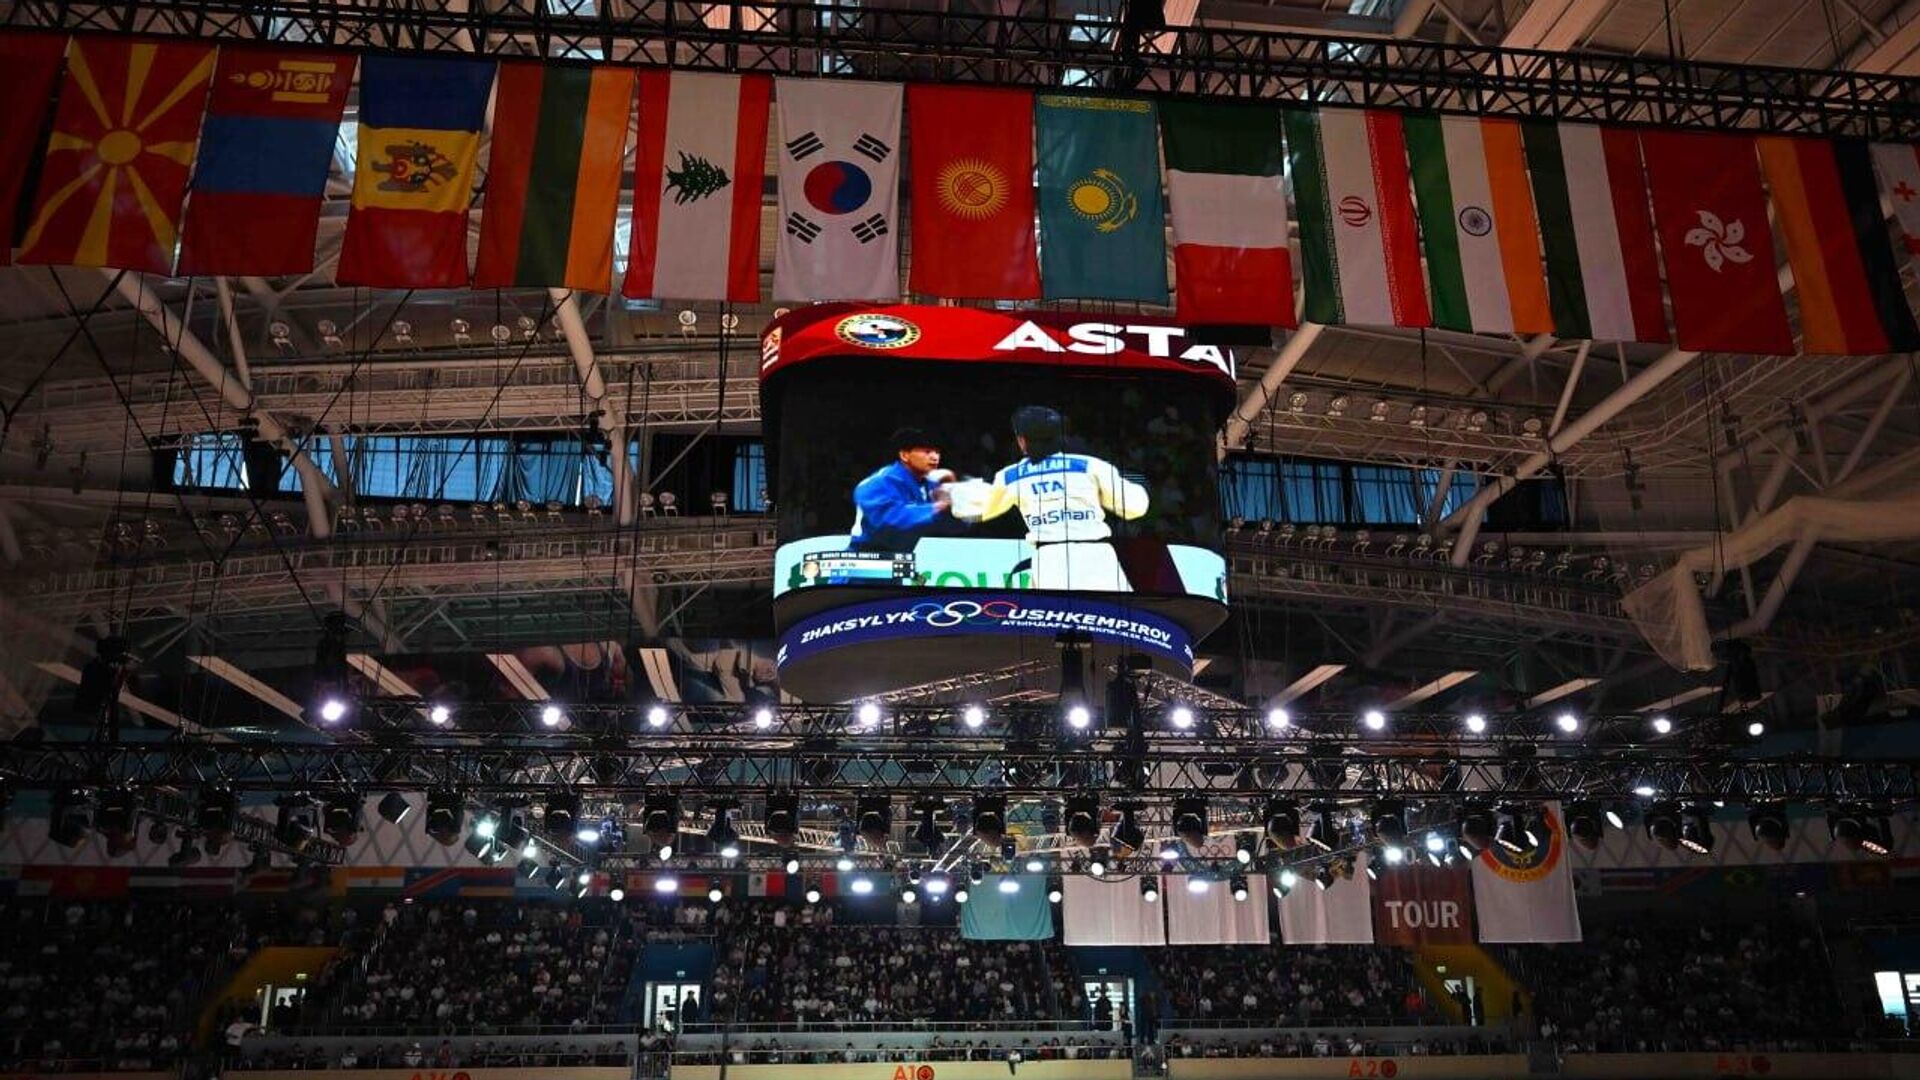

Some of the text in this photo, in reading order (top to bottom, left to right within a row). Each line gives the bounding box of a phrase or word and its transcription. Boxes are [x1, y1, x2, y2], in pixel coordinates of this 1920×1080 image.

[992, 319, 1236, 381] ASTA
[1031, 480, 1064, 495] ITA
[1025, 508, 1096, 527] TaiShan
[800, 608, 1172, 643] ZHAKSYLYK USHKEMPIROV
[1384, 900, 1460, 929] TOUR
